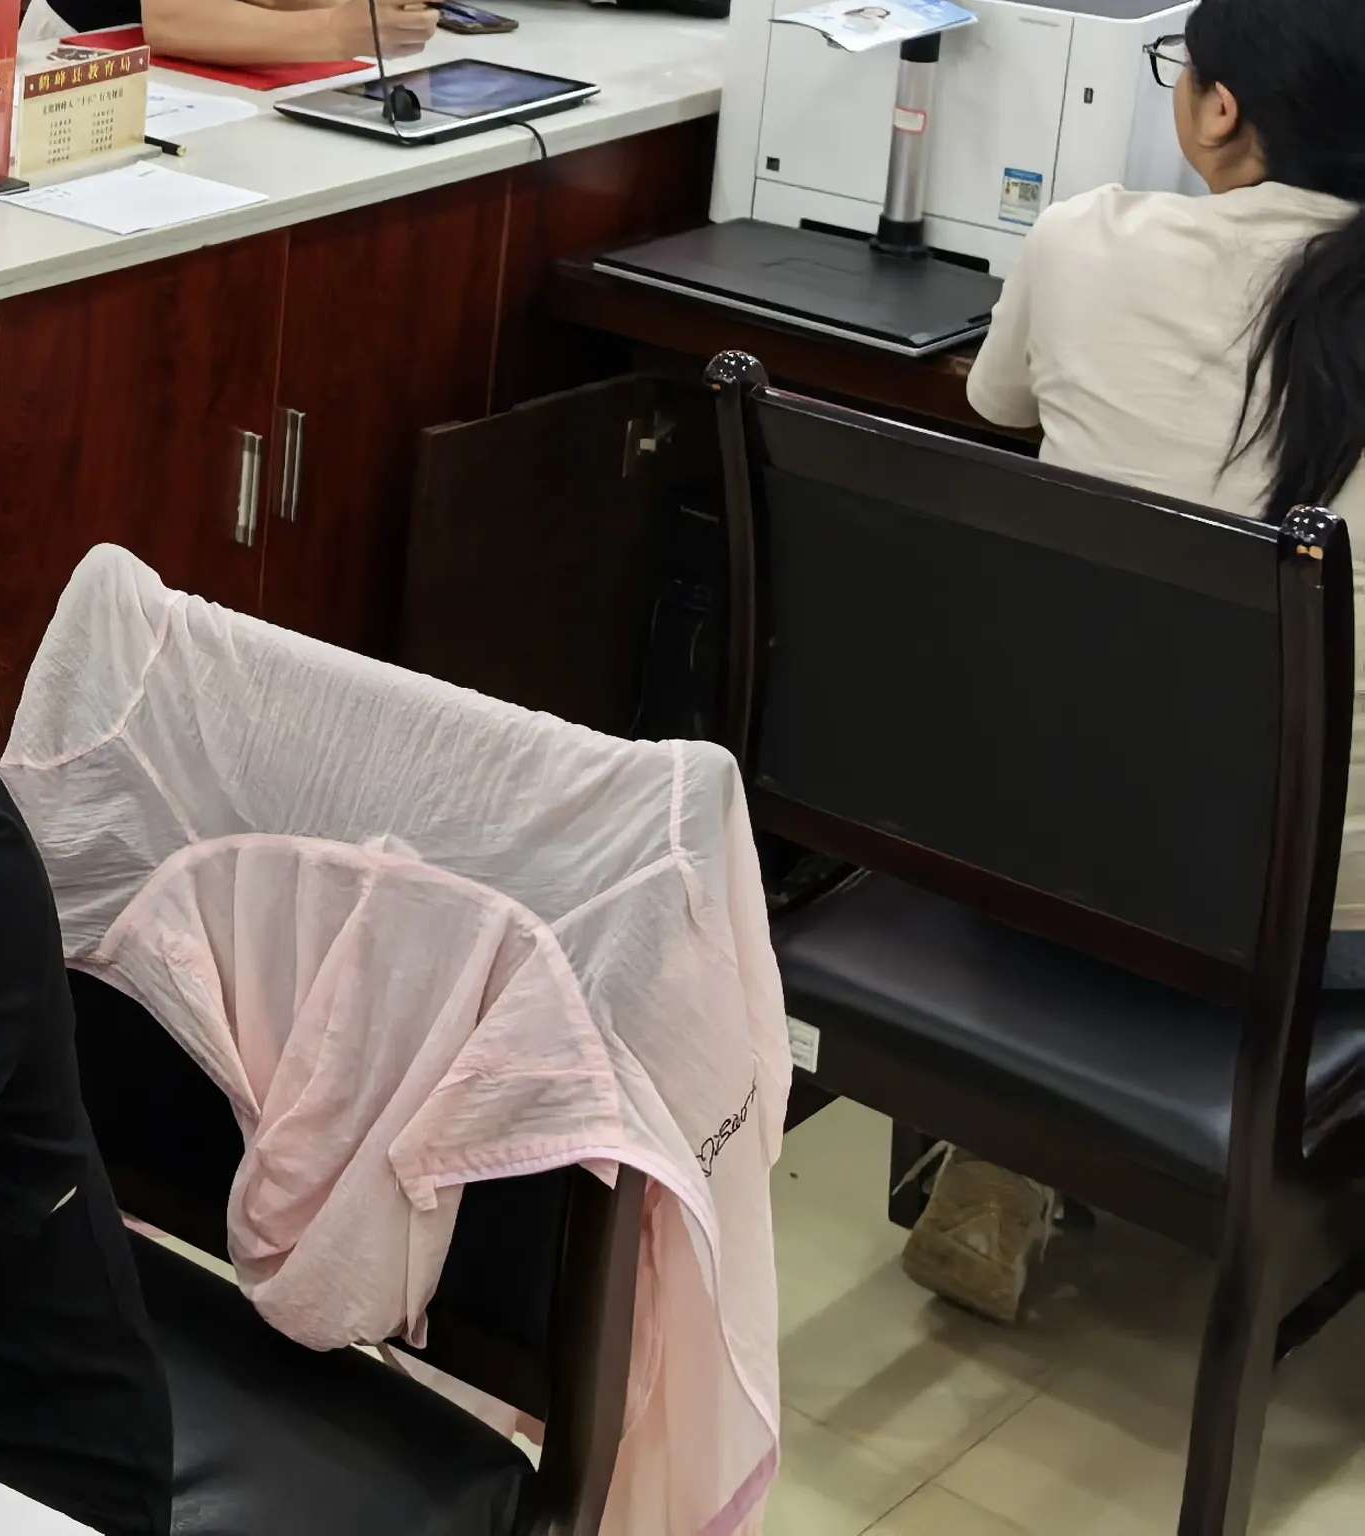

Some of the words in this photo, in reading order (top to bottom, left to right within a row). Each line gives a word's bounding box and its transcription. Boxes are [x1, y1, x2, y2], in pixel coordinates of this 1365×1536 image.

[38, 55, 131, 91] 鹤峰县教育局
